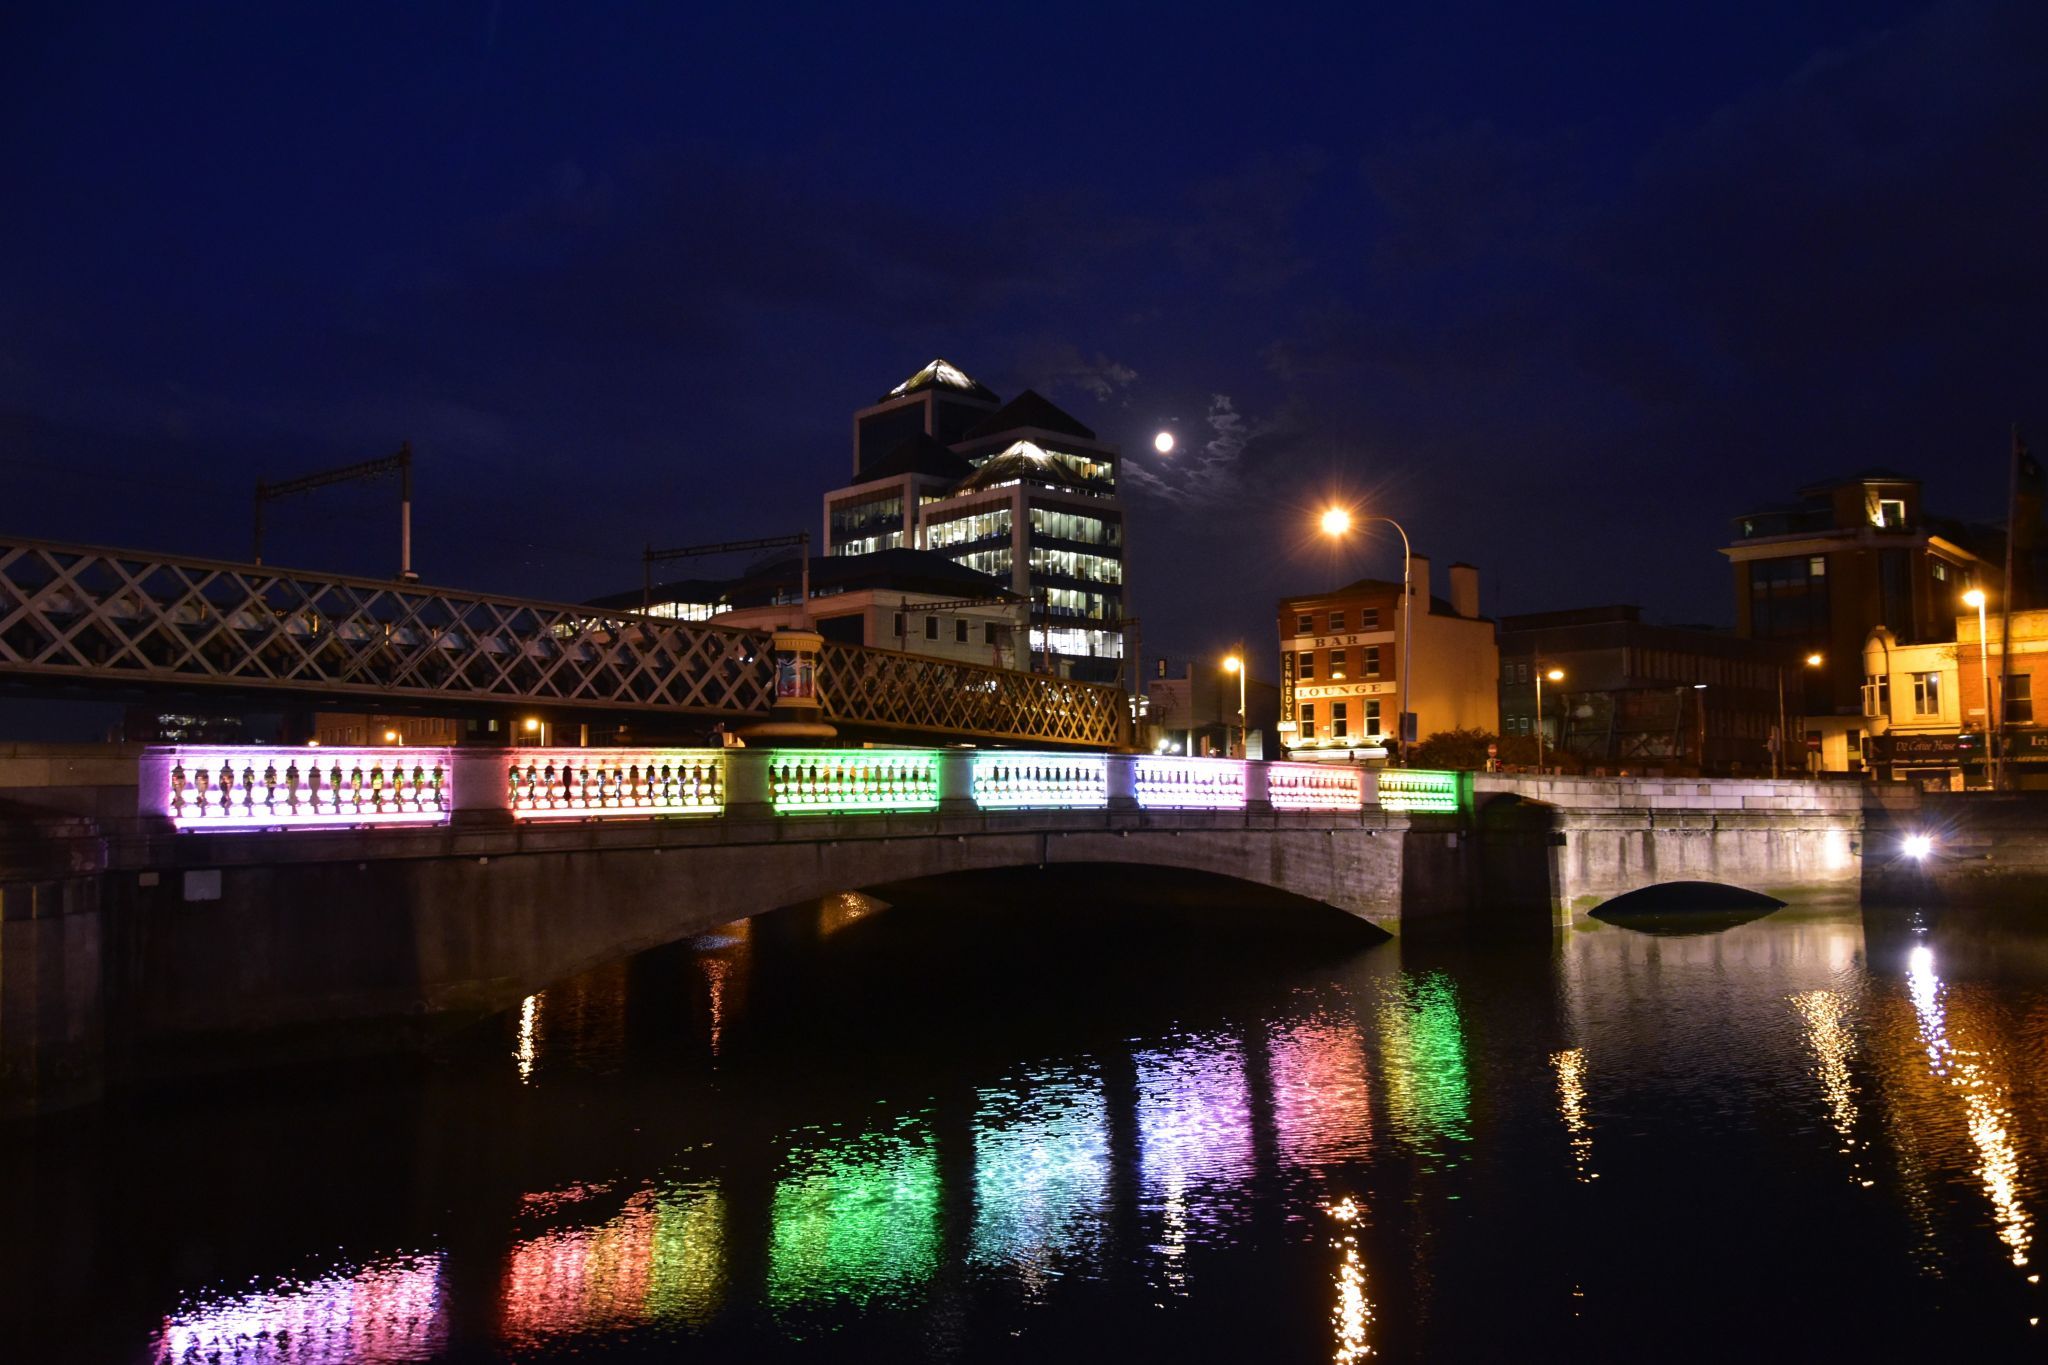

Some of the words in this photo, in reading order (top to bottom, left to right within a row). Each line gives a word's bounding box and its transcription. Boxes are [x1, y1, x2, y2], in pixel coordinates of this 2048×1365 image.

[1315, 635, 1358, 647] BAR
[1284, 653, 1293, 720] KENNEDYS
[1299, 684, 1381, 697] LOUNGE
